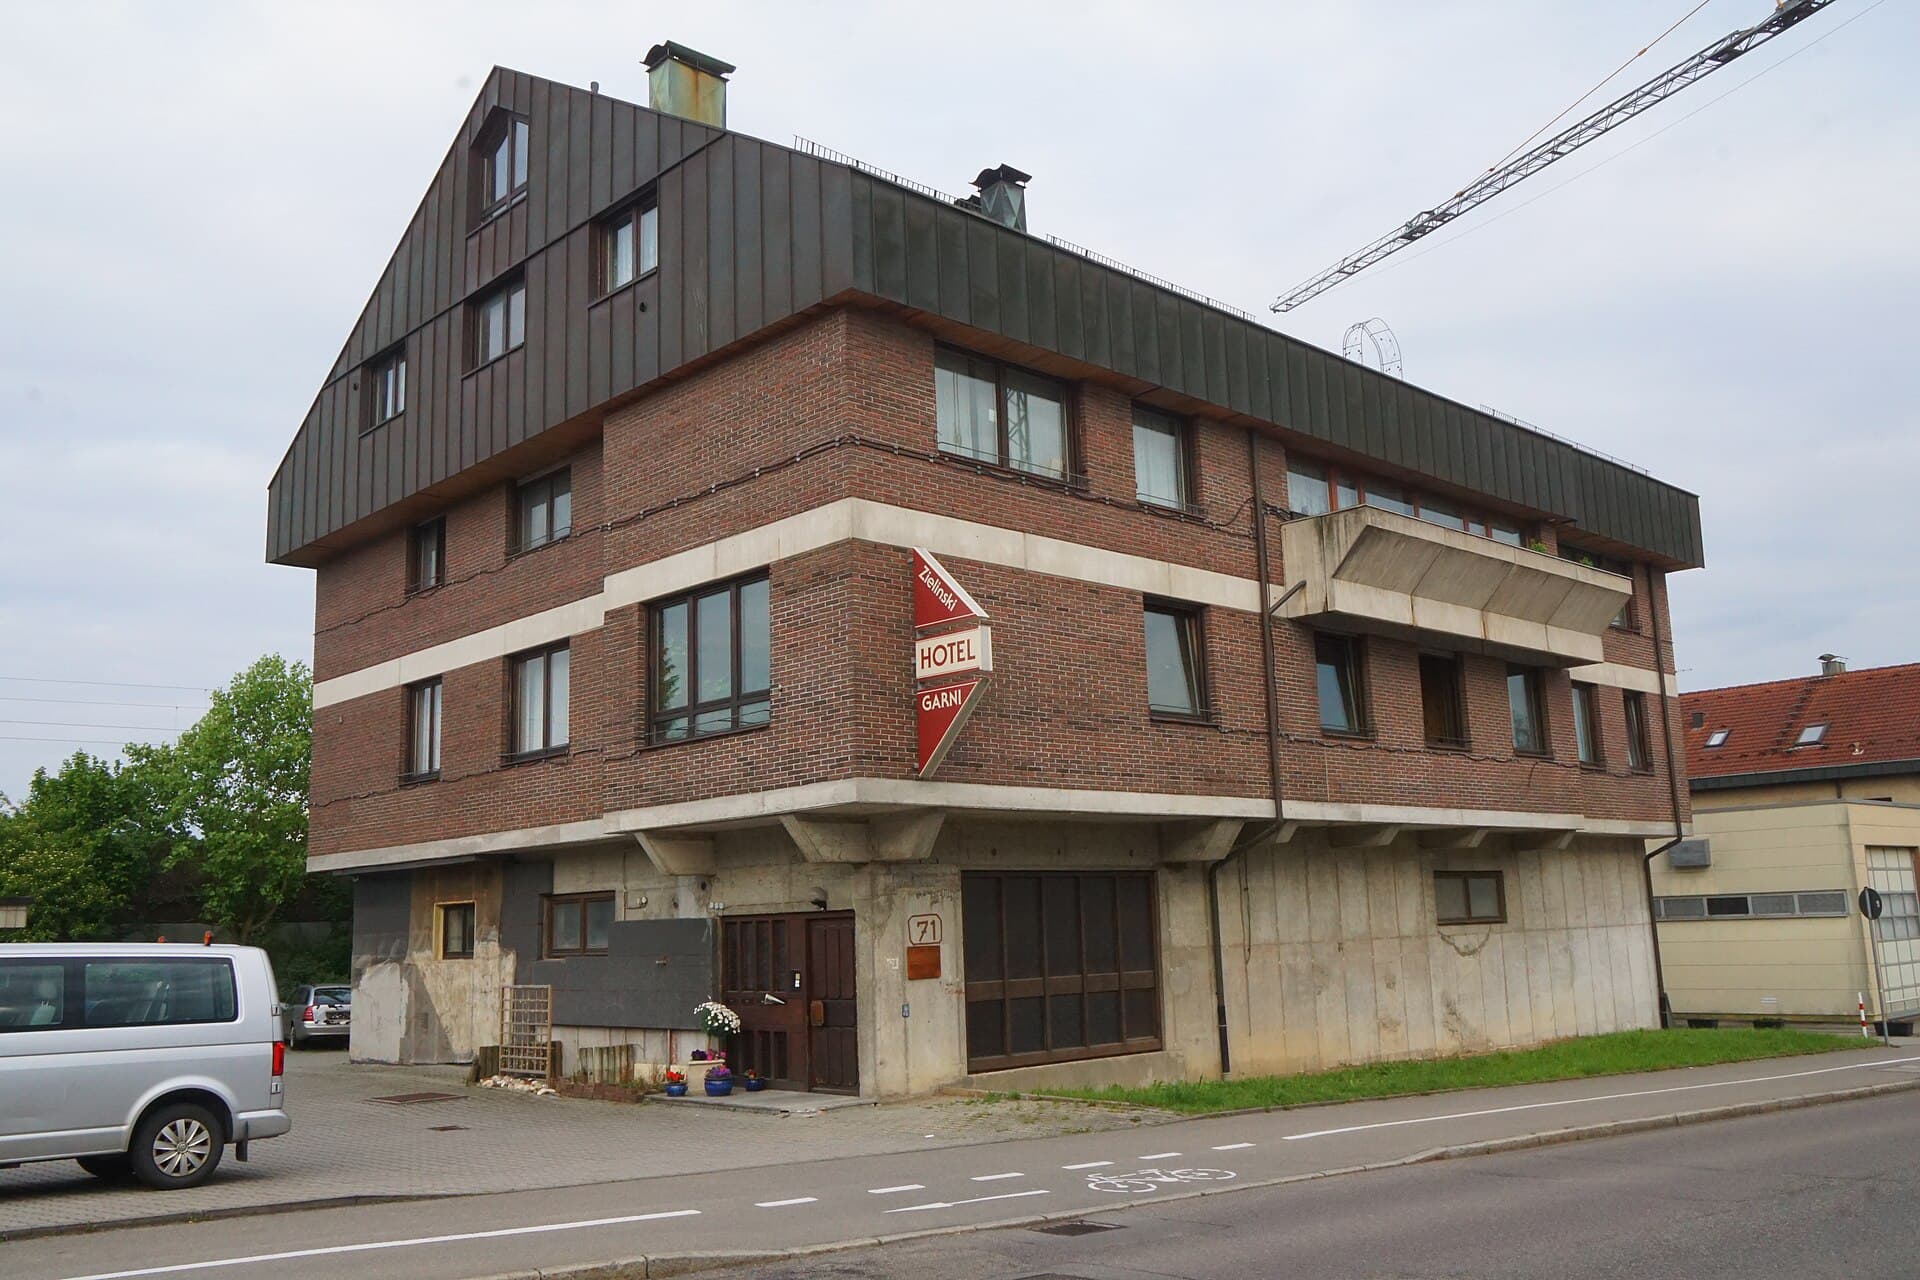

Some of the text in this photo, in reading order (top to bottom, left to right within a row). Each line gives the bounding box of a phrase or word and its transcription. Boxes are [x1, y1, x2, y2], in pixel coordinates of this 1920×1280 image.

[918, 565, 957, 612] Zielinski
[921, 638, 976, 669] HOTEL
[922, 689, 962, 711] GARNI
[916, 919, 936, 942] 71
